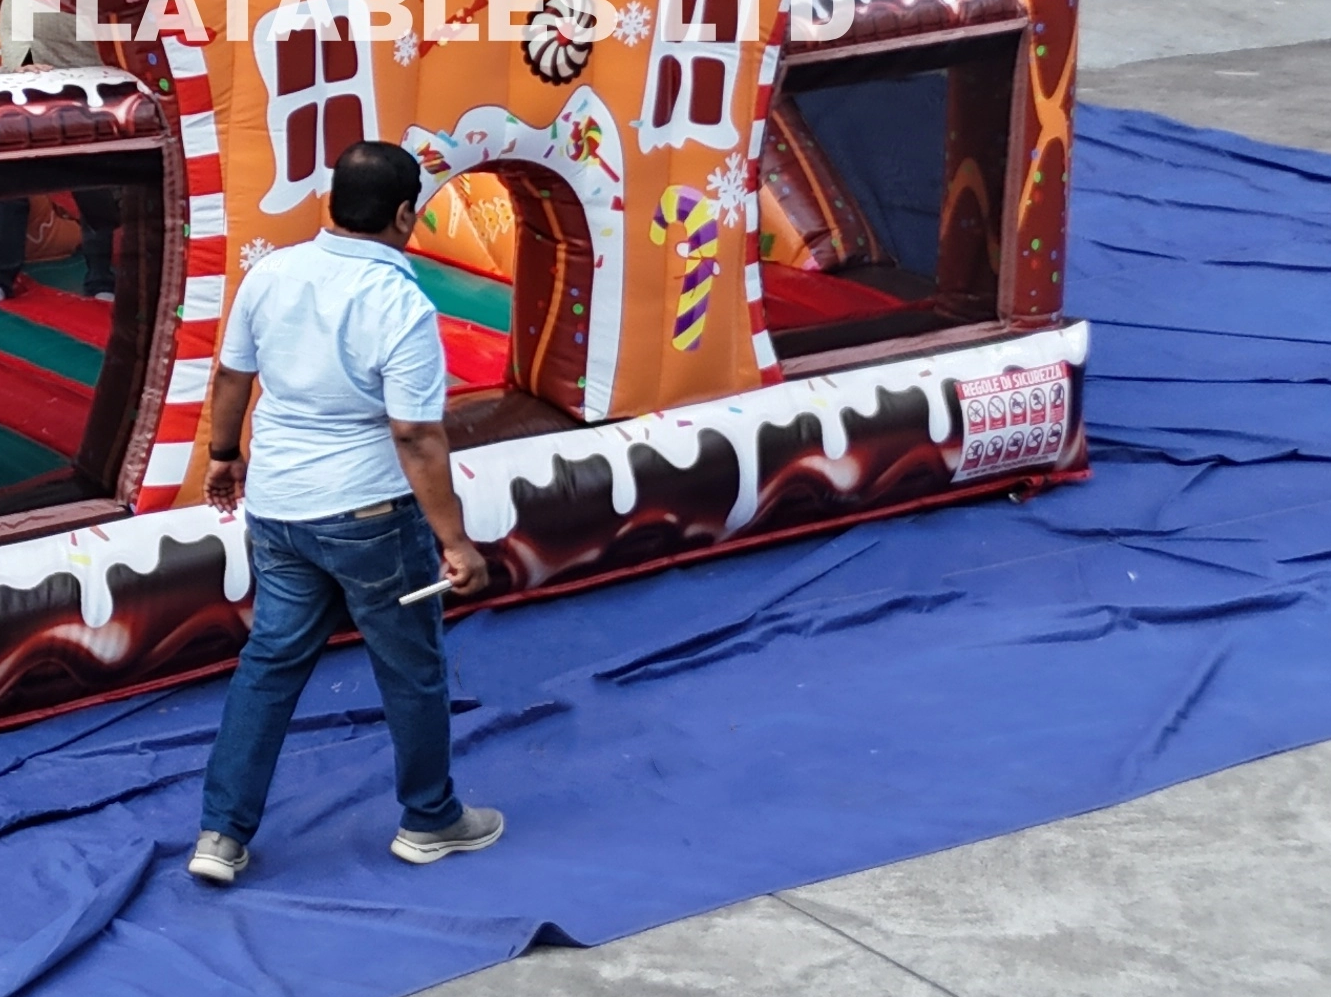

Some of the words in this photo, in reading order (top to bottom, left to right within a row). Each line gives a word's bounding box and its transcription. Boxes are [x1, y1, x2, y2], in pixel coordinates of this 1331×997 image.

[962, 378, 1000, 397] REGOLE
[1000, 373, 1012, 390] DI
[1013, 365, 1062, 387] SICUREZZA
